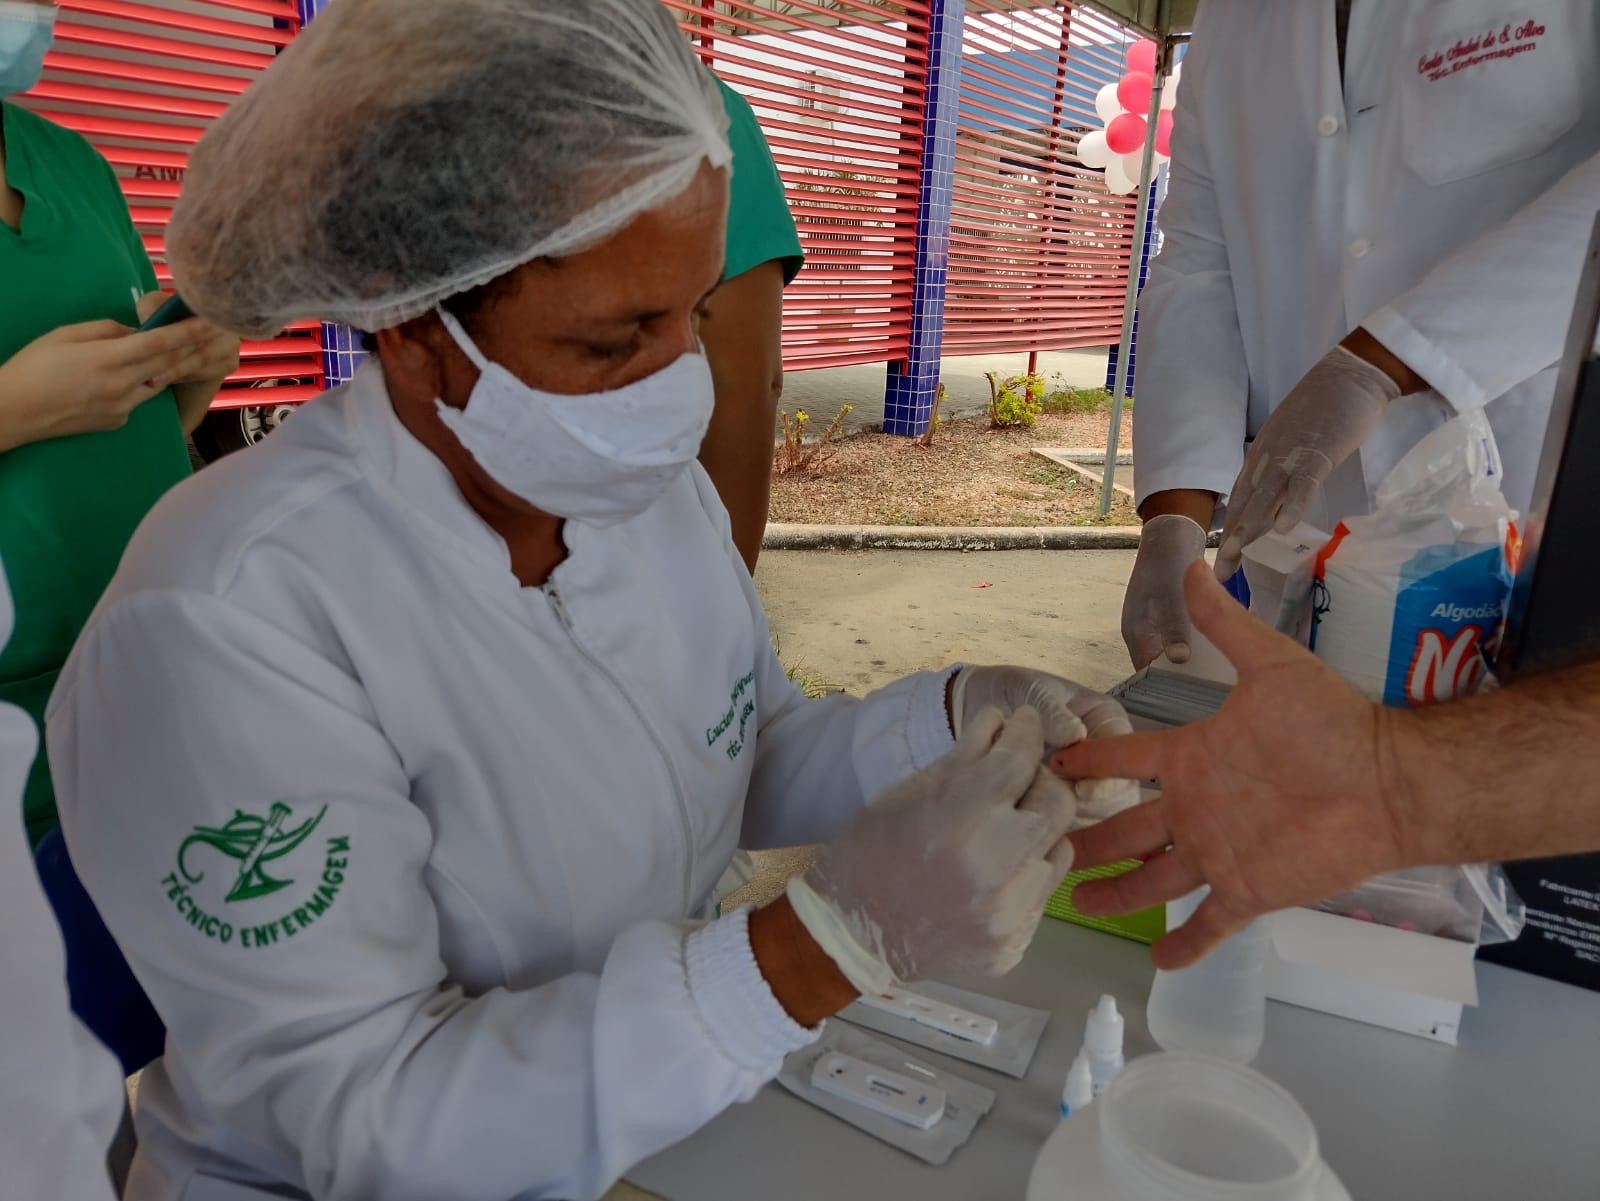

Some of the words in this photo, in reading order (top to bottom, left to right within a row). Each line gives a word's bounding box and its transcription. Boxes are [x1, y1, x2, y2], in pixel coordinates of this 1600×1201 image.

[1452, 42, 1536, 72] Enfermagem
[160, 871, 233, 944] TÉCNICO
[239, 835, 351, 948] ENFERMAGEM
